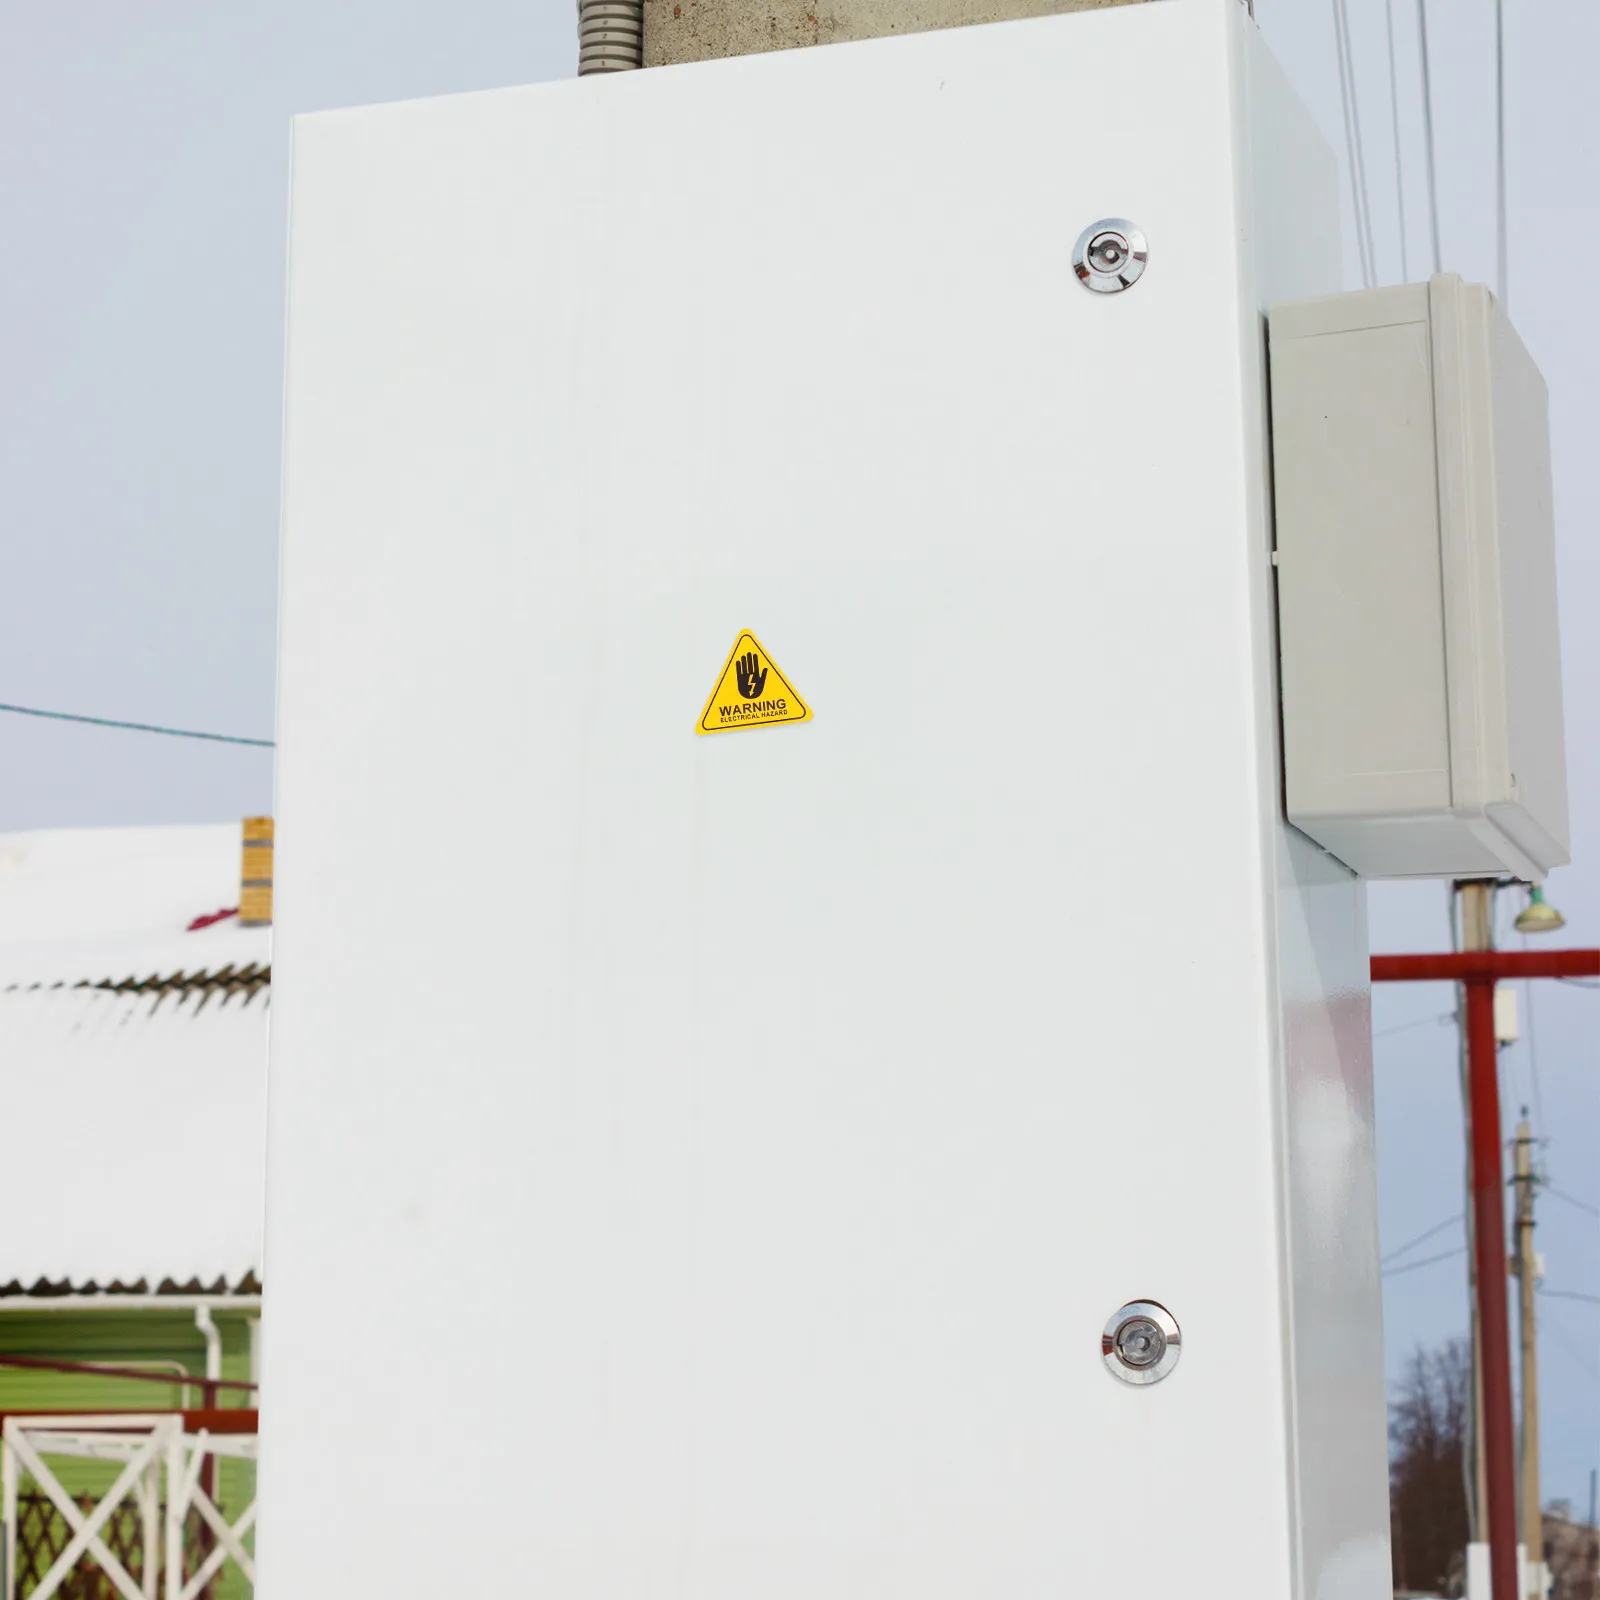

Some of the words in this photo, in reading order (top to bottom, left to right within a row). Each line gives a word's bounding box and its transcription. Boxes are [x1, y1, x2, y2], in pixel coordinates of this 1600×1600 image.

[719, 698, 786, 716] WARNING
[720, 713, 760, 723] ELECTRICAL
[761, 709, 788, 718] HAZARD
